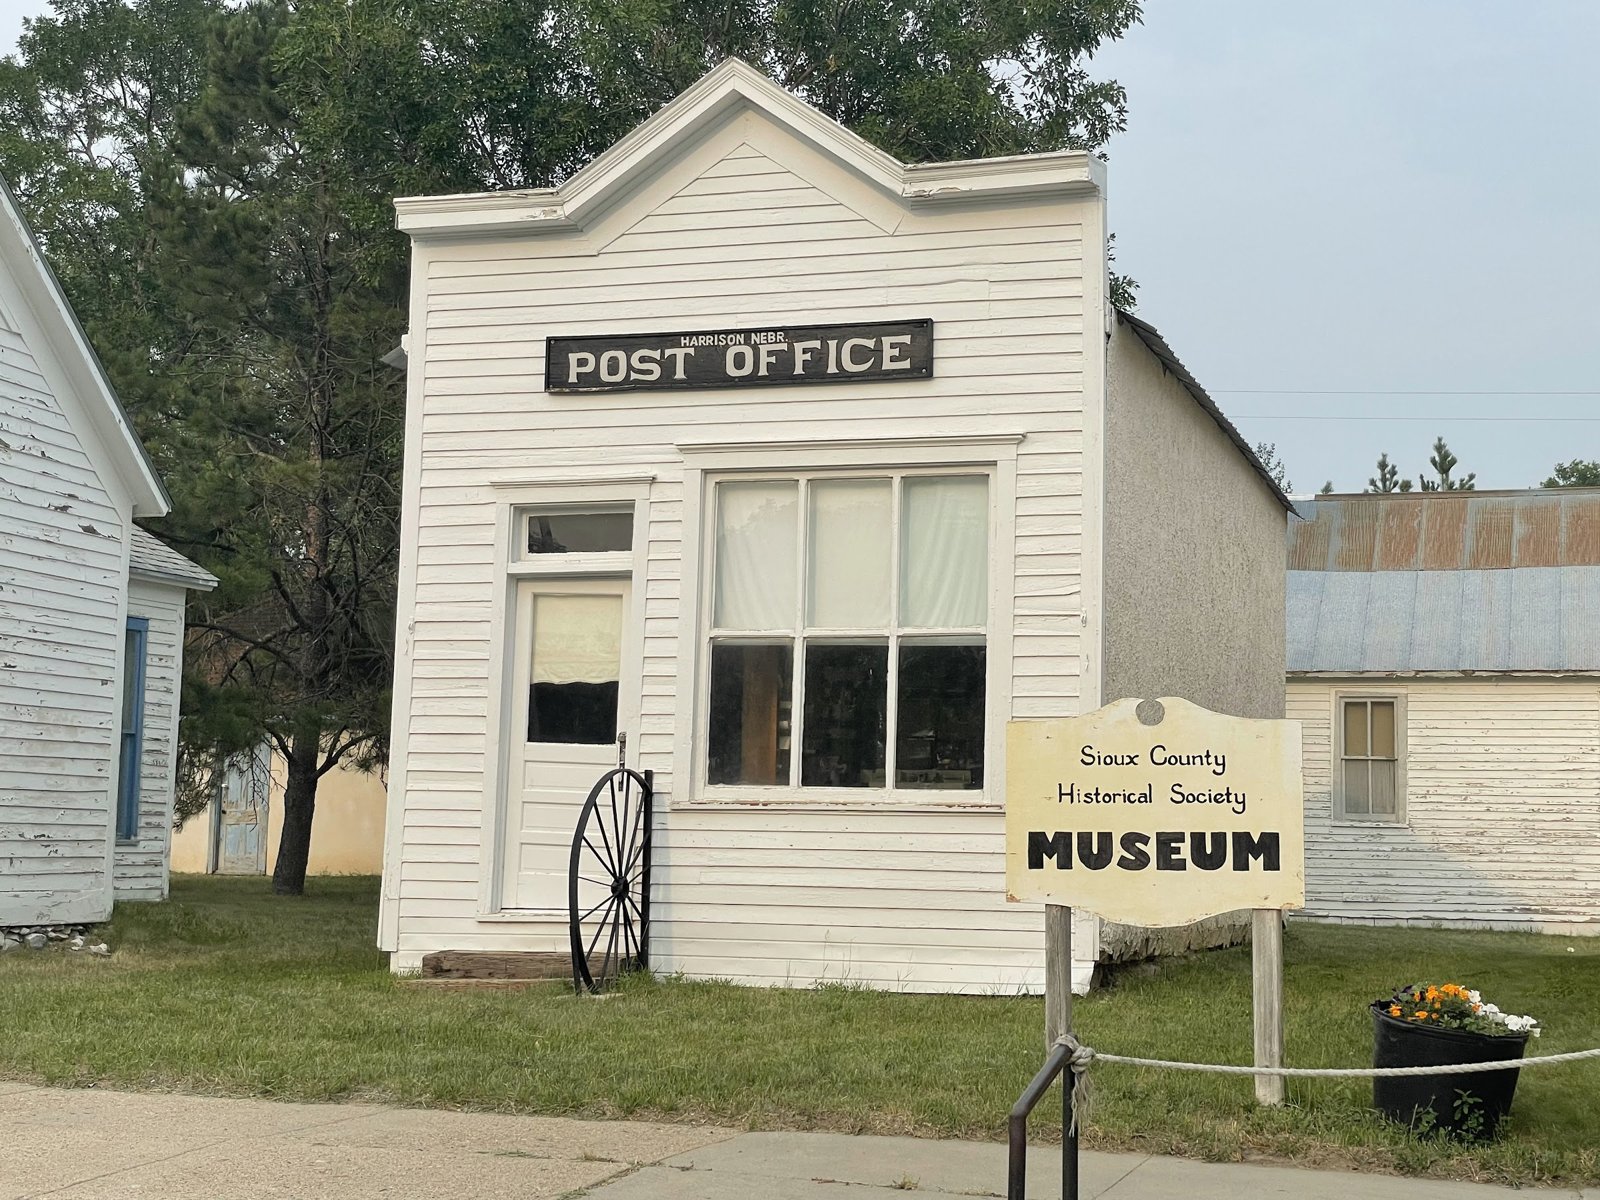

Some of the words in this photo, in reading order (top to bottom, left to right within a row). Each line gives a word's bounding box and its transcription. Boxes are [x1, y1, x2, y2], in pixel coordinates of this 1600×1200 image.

[681, 332, 745, 347] HARRISON
[751, 331, 789, 345] NEBR.
[567, 347, 695, 384] POST
[724, 334, 912, 377] OFFICE
[1080, 745, 1140, 766] Sioux
[1149, 744, 1227, 776] County
[1057, 783, 1153, 804] Historical
[1170, 783, 1247, 815] Society
[1028, 831, 1281, 872] MUSEUM
